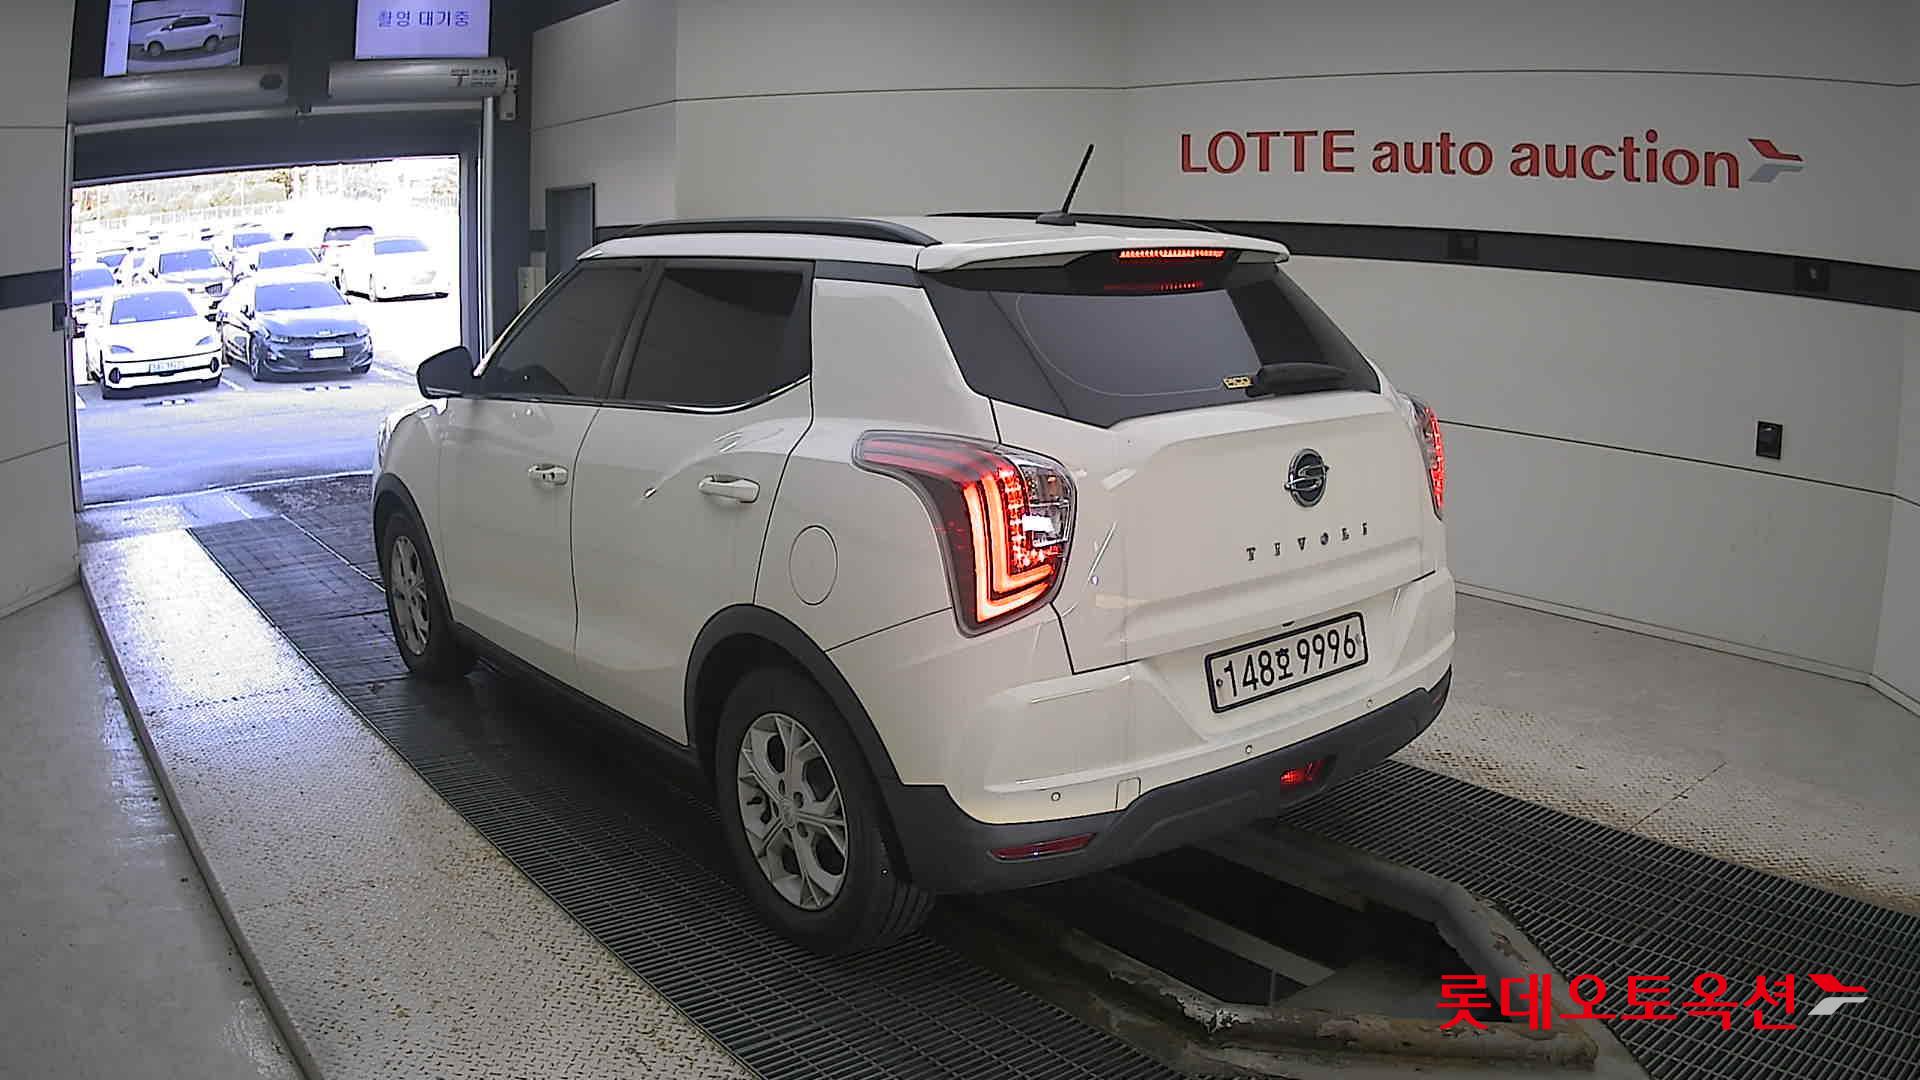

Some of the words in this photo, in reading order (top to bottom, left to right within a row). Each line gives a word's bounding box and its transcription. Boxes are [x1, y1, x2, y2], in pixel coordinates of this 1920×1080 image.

[419, 10, 469, 28] 대기중
[1180, 129, 1355, 174] LOTTE
[1371, 131, 1494, 176] auto
[1510, 128, 1741, 189] auction
[1246, 522, 1368, 562] TIVOLI
